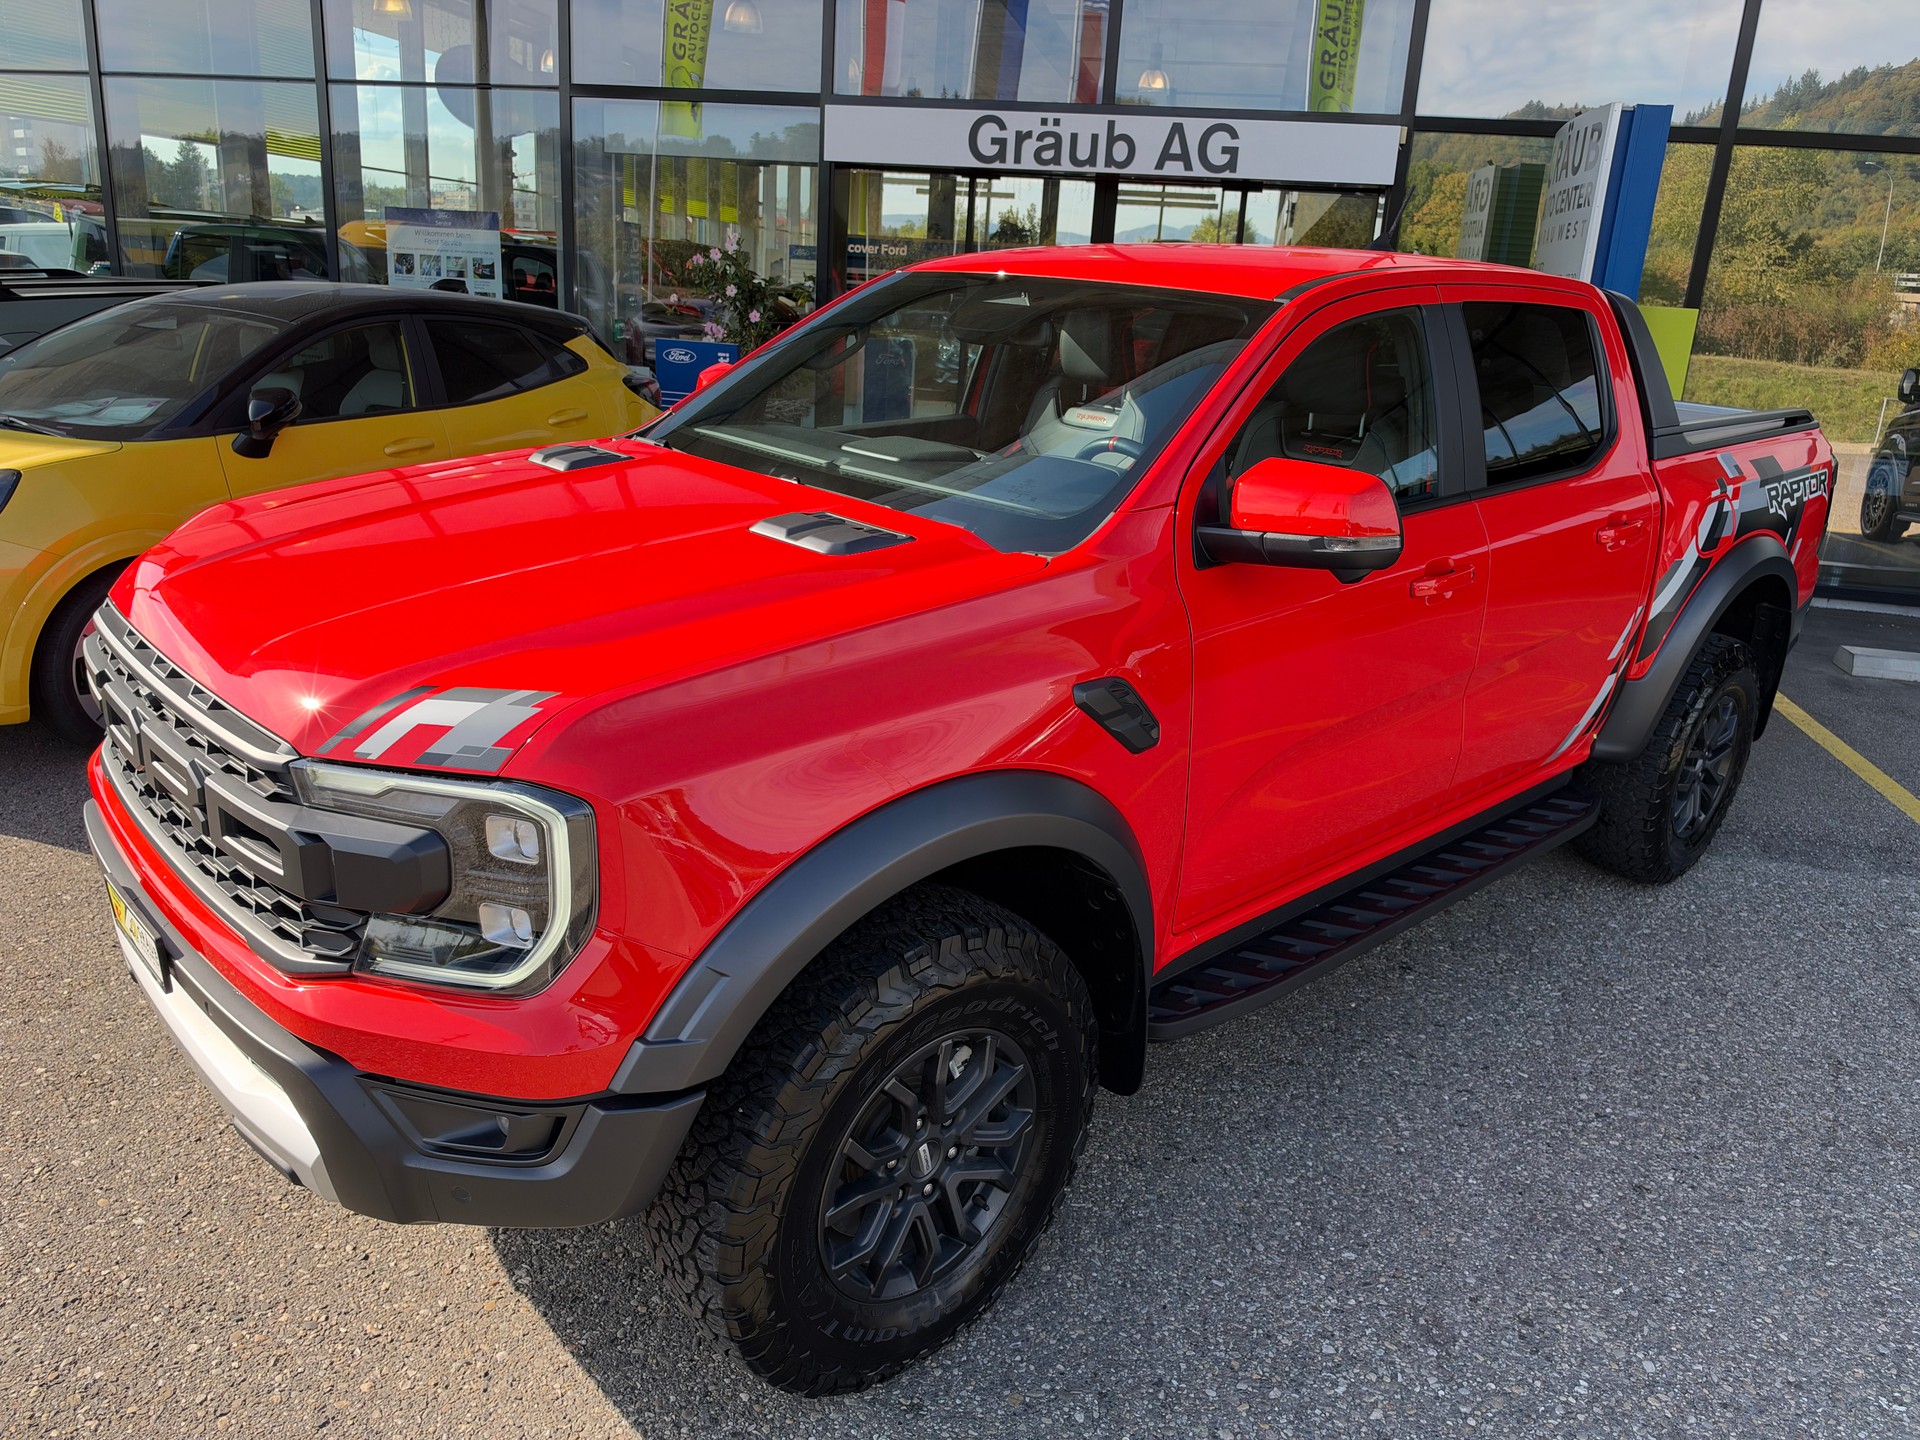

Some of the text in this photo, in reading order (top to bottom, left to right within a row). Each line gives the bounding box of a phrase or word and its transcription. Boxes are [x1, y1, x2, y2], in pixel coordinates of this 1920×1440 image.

[1319, 0, 1343, 90] GRÄU
[968, 114, 1240, 174] Gräub AG
[414, 229, 472, 239] Willkommen beim
[1557, 218, 1588, 241] WEST
[847, 243, 908, 256] cover Ford
[875, 353, 901, 367] Ford
[1765, 468, 1829, 521] RAPTOR
